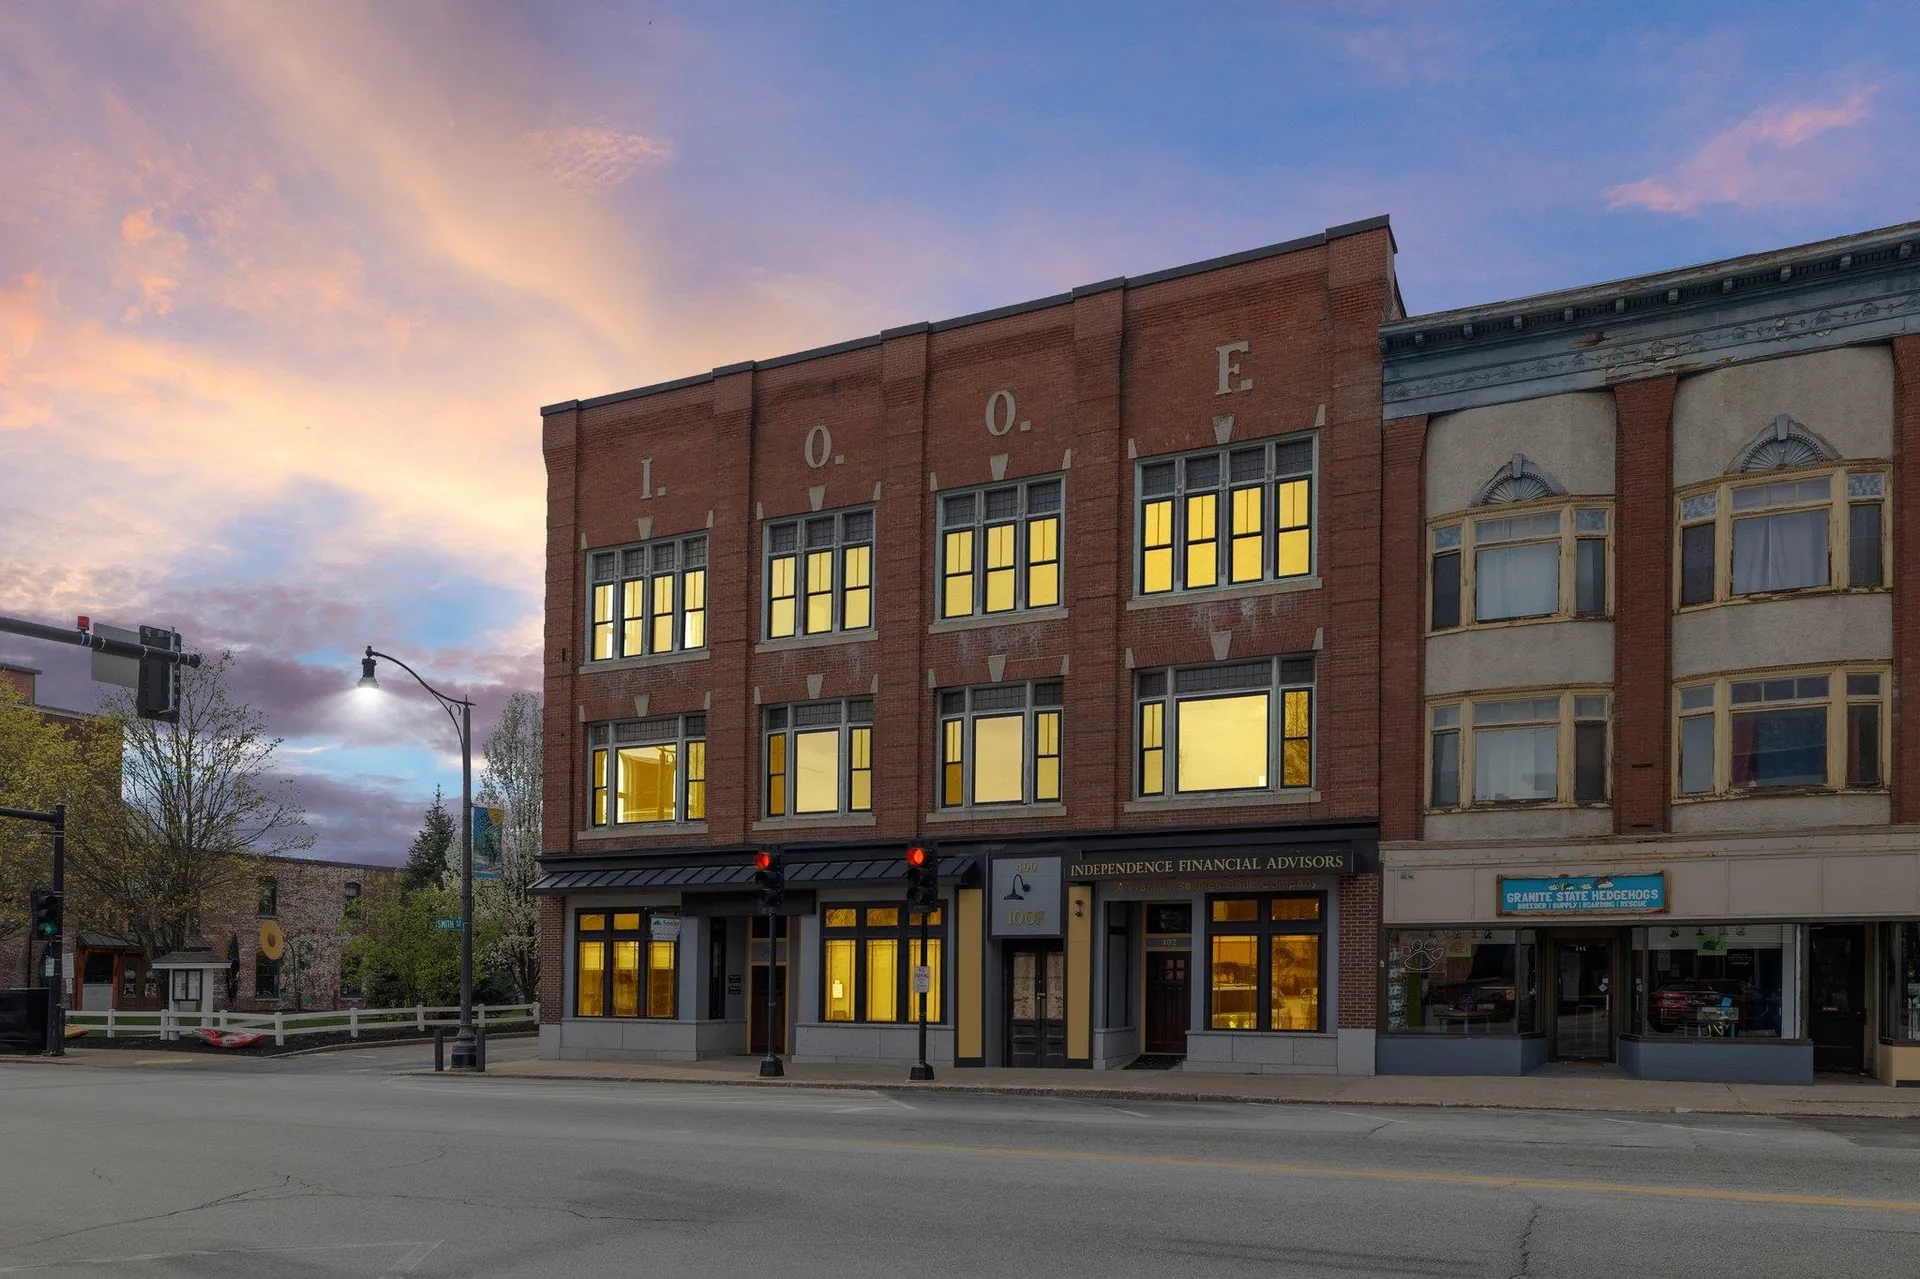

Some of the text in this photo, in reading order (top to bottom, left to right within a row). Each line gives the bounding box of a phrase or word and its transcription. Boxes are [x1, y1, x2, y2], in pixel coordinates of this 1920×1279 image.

[640, 341, 1253, 500] I. O. O. F.
[1070, 855, 1344, 876] INDEPENDENCE FINANCIAL ADVISORS
[1506, 888, 1659, 903] GRANITE STATE HEDGEHOGS
[1517, 900, 1648, 910] BREEDER SUPPLY BOARDING RESCUE
